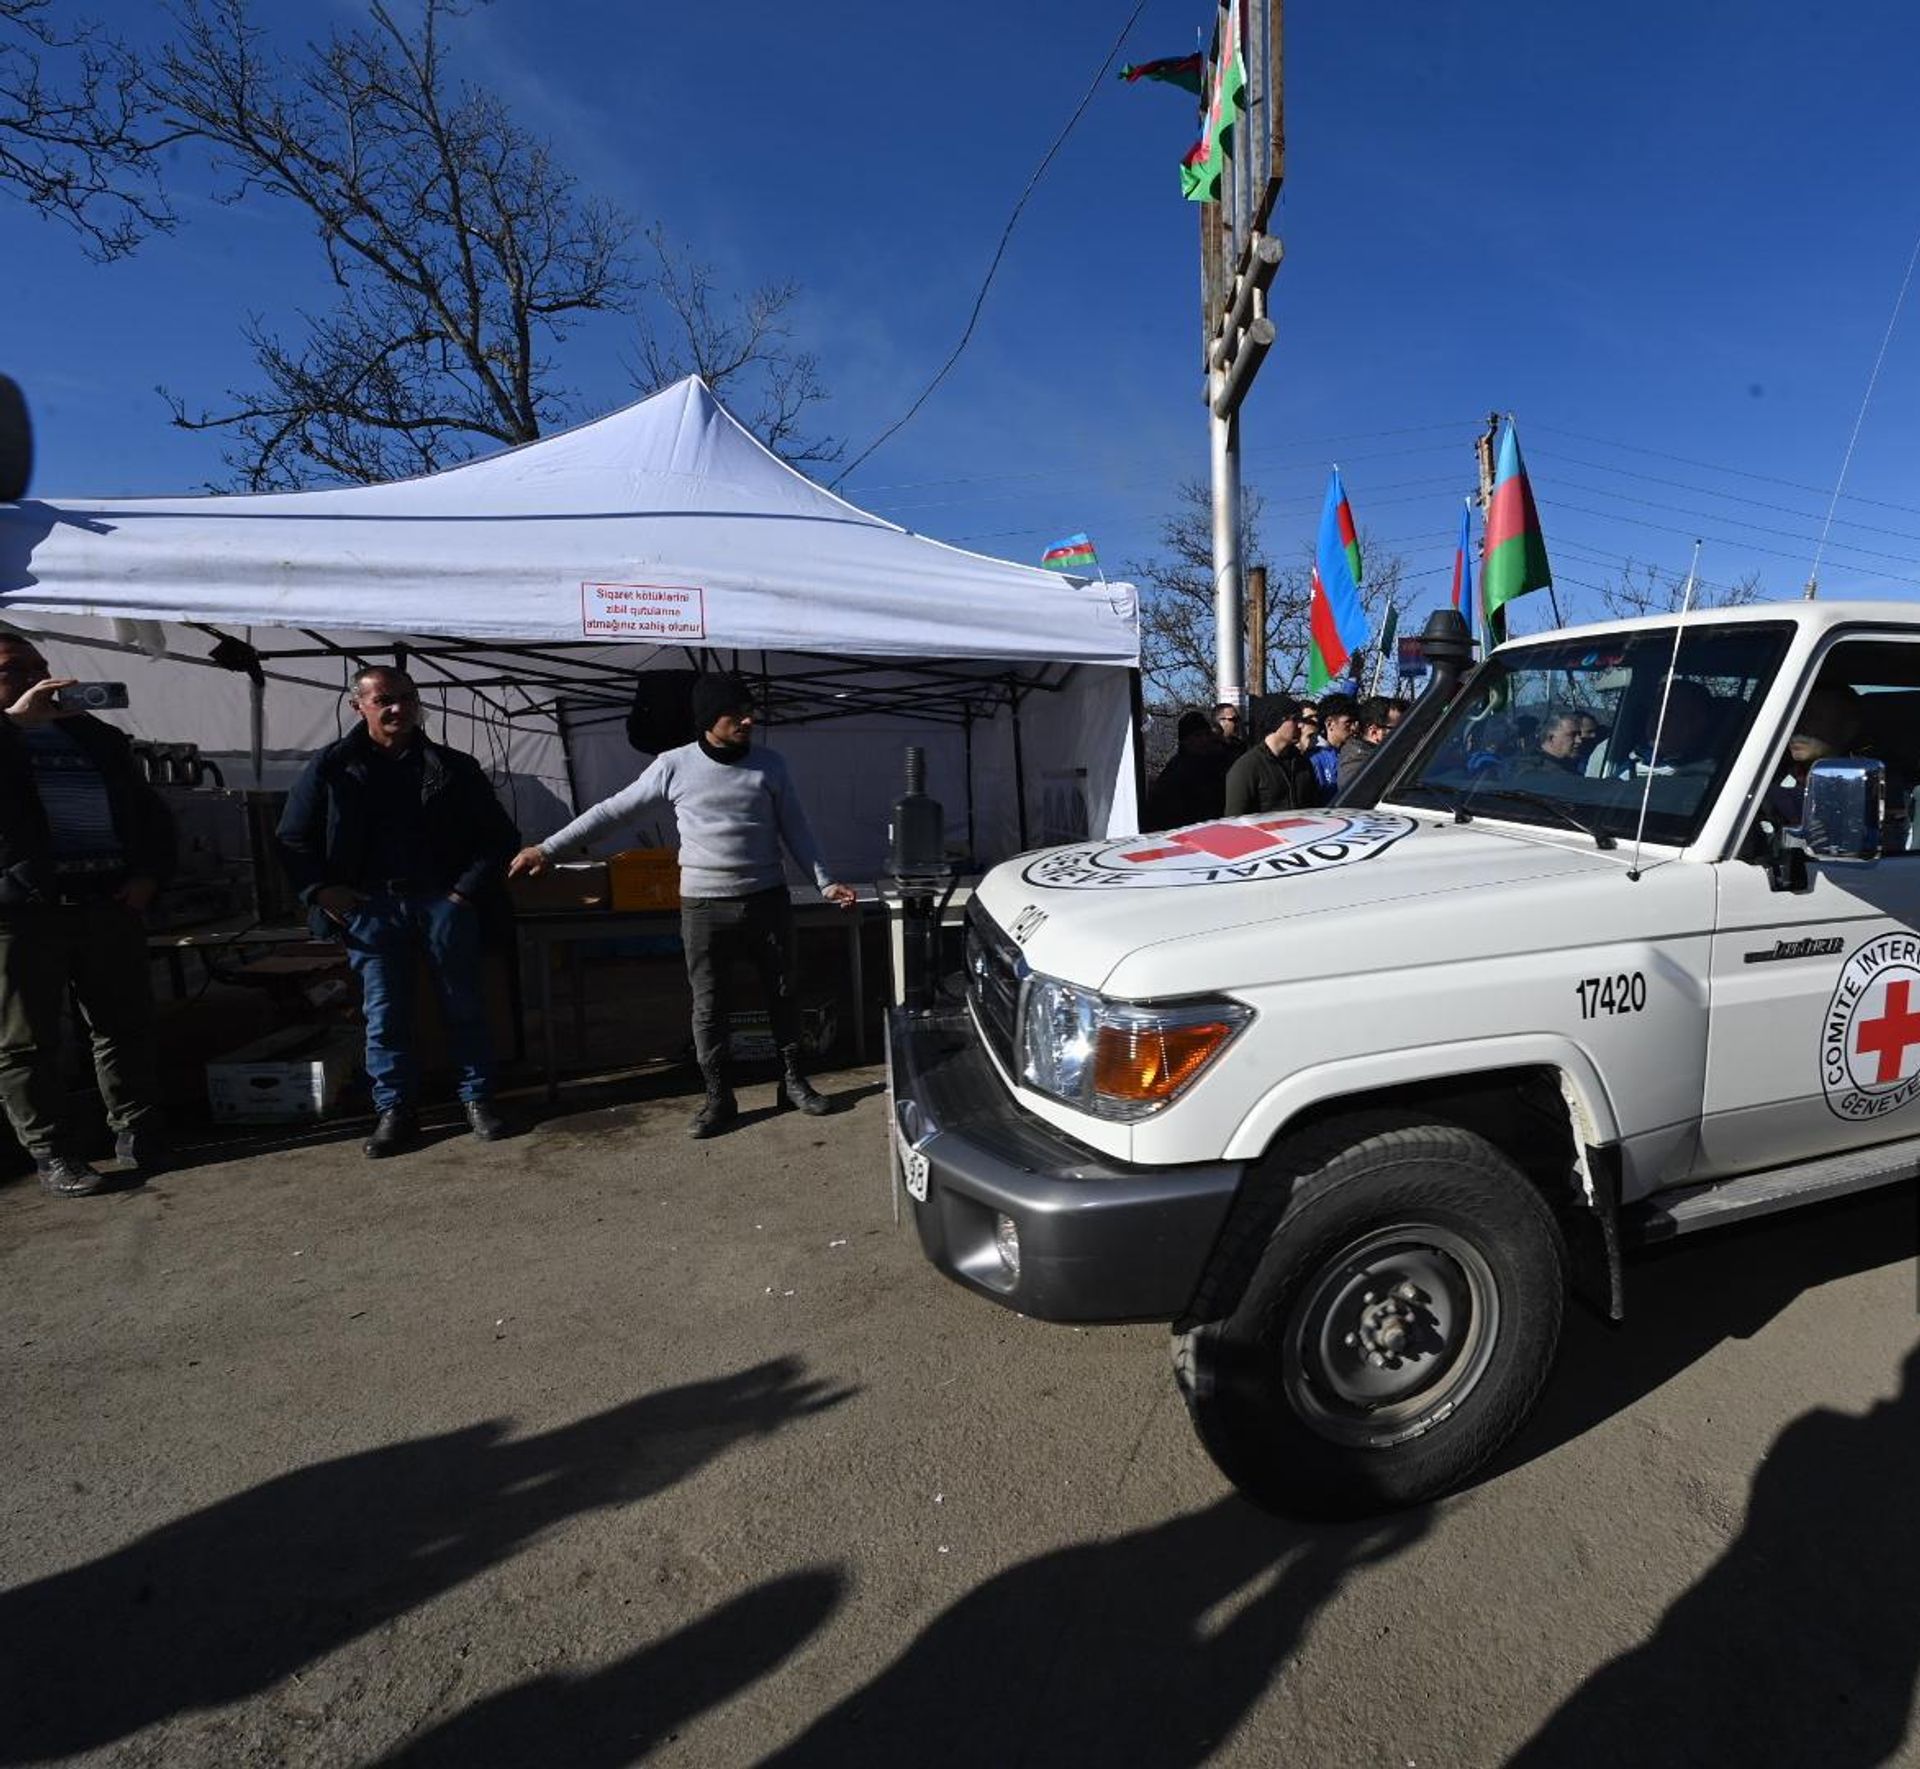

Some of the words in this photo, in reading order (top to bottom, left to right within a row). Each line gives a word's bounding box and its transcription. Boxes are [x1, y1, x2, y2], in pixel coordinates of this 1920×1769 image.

[596, 588, 634, 600] Siqaret
[606, 604, 627, 614] zibil
[668, 622, 700, 633] olunur
[1575, 971, 1646, 1020] 17420
[1826, 976, 1862, 1085] COMITE
[1841, 1077, 1919, 1115] GENEVE
